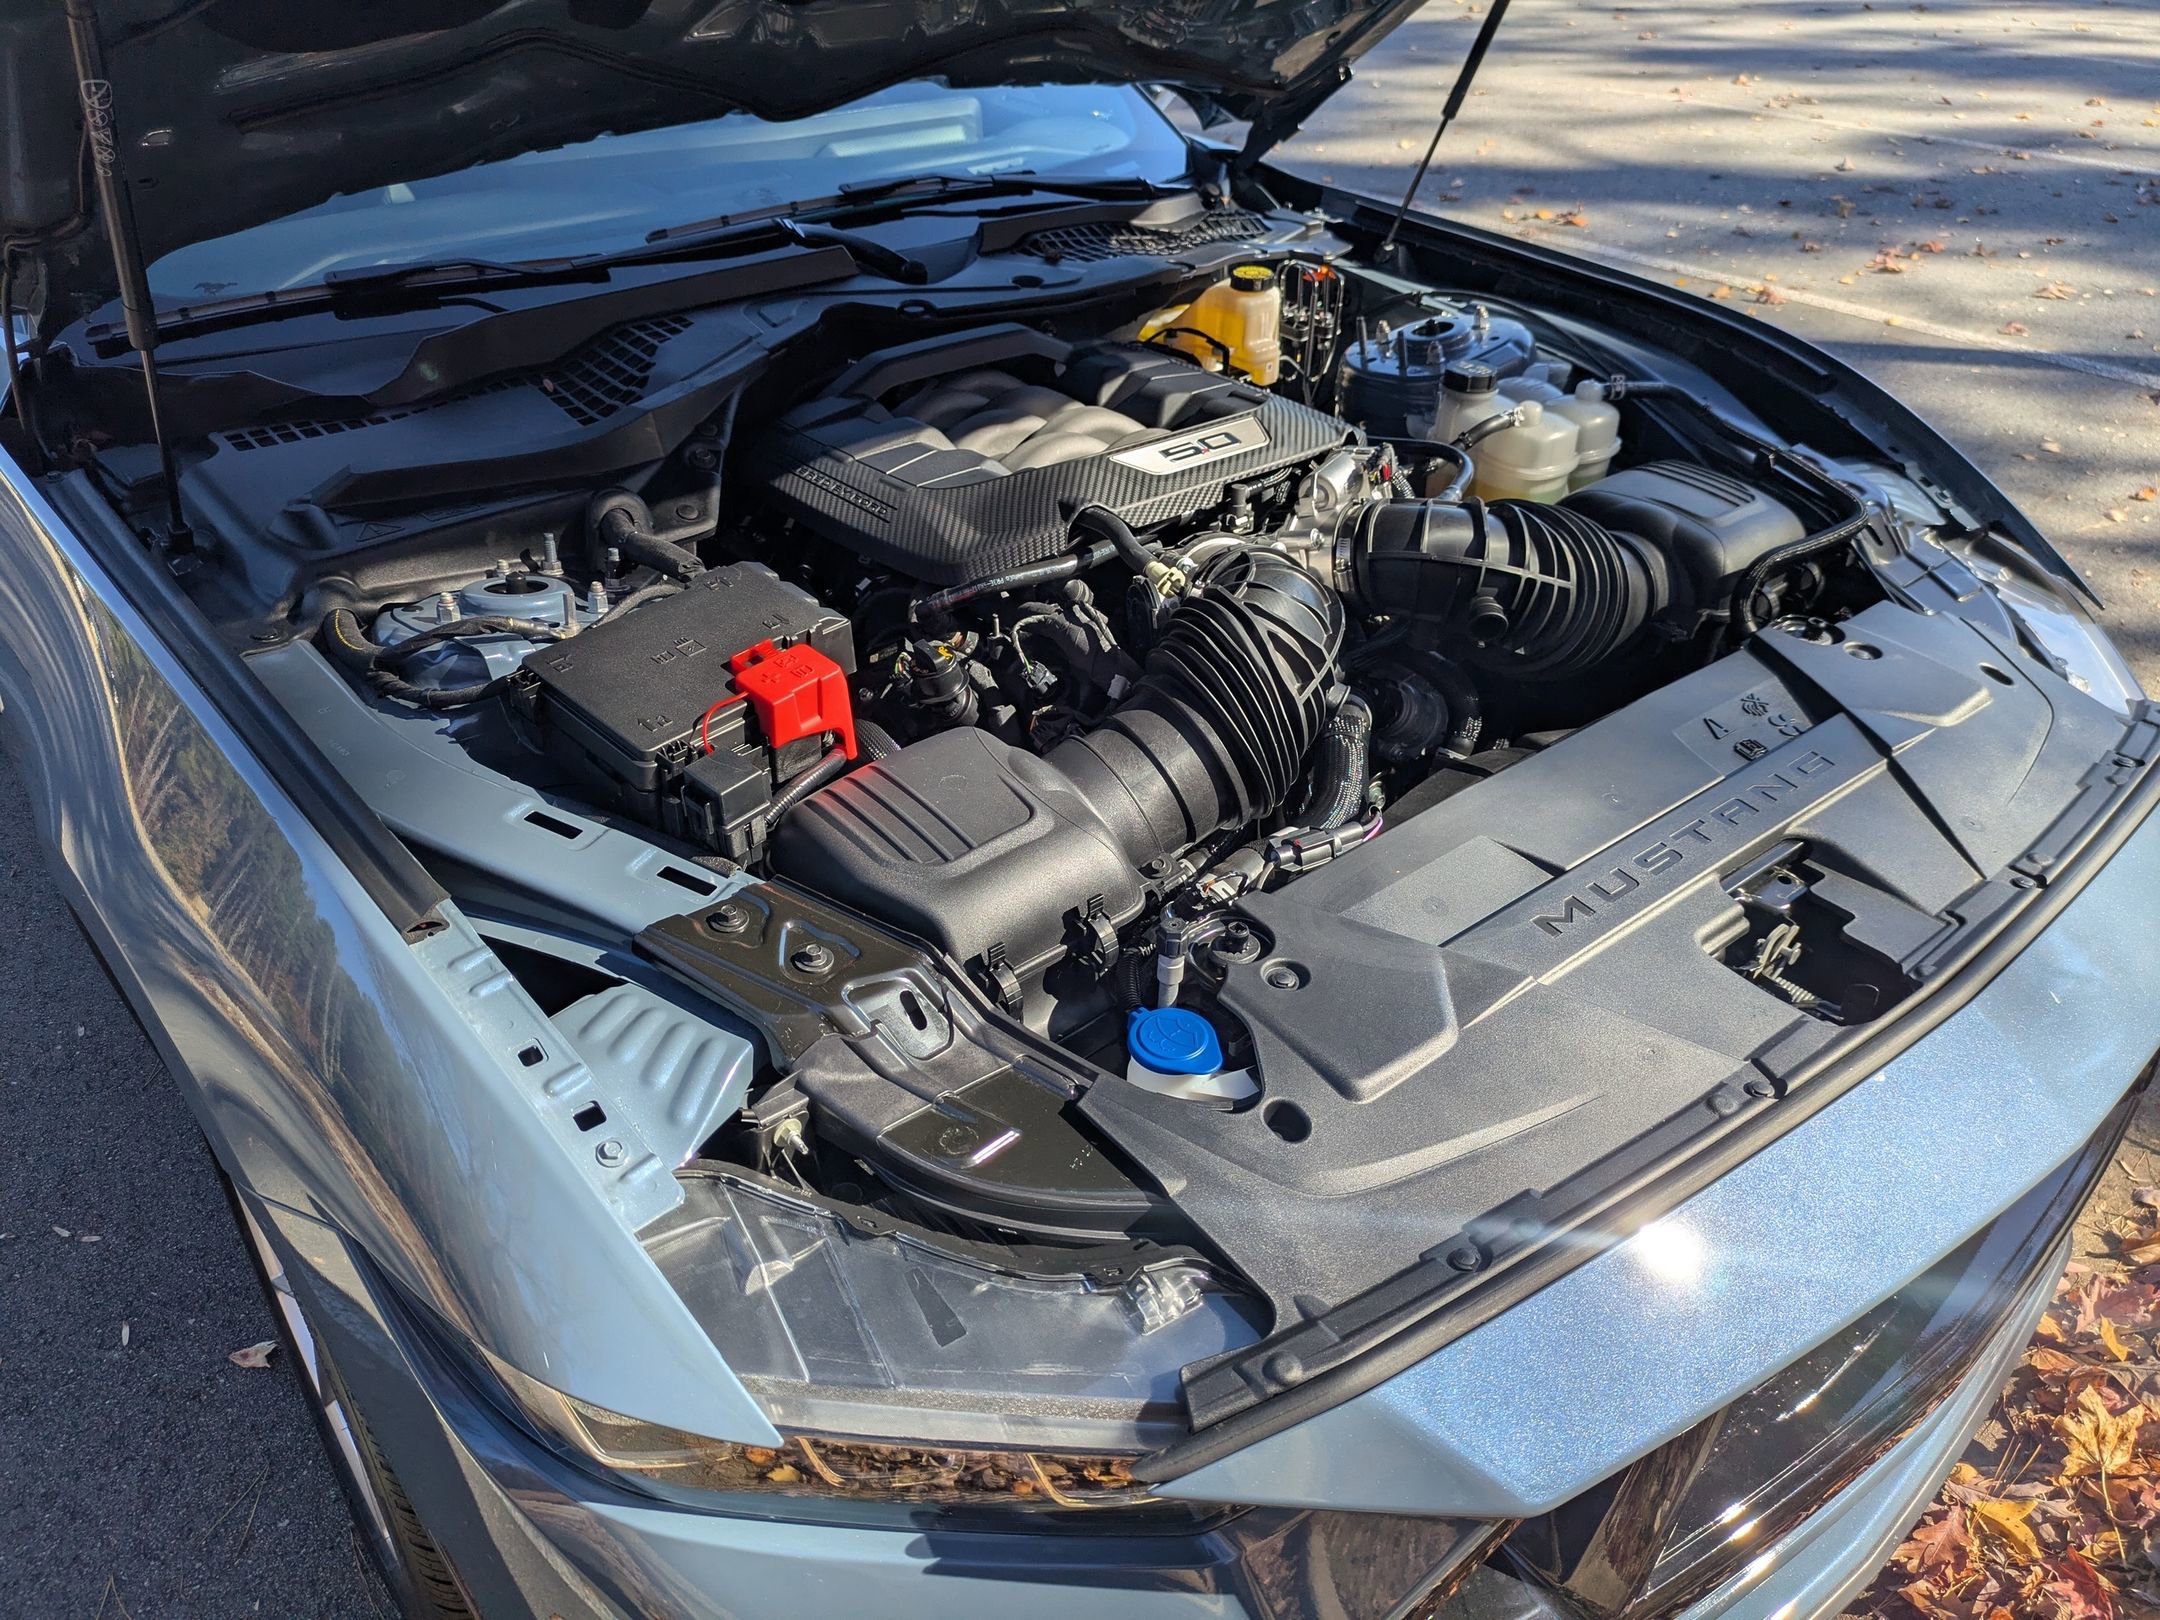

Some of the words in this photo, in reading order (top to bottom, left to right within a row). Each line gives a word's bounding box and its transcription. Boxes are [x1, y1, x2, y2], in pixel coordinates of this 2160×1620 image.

[831, 483, 852, 496] BY
[850, 493, 888, 515] FORD
[1529, 751, 1836, 938] MUSTANG
